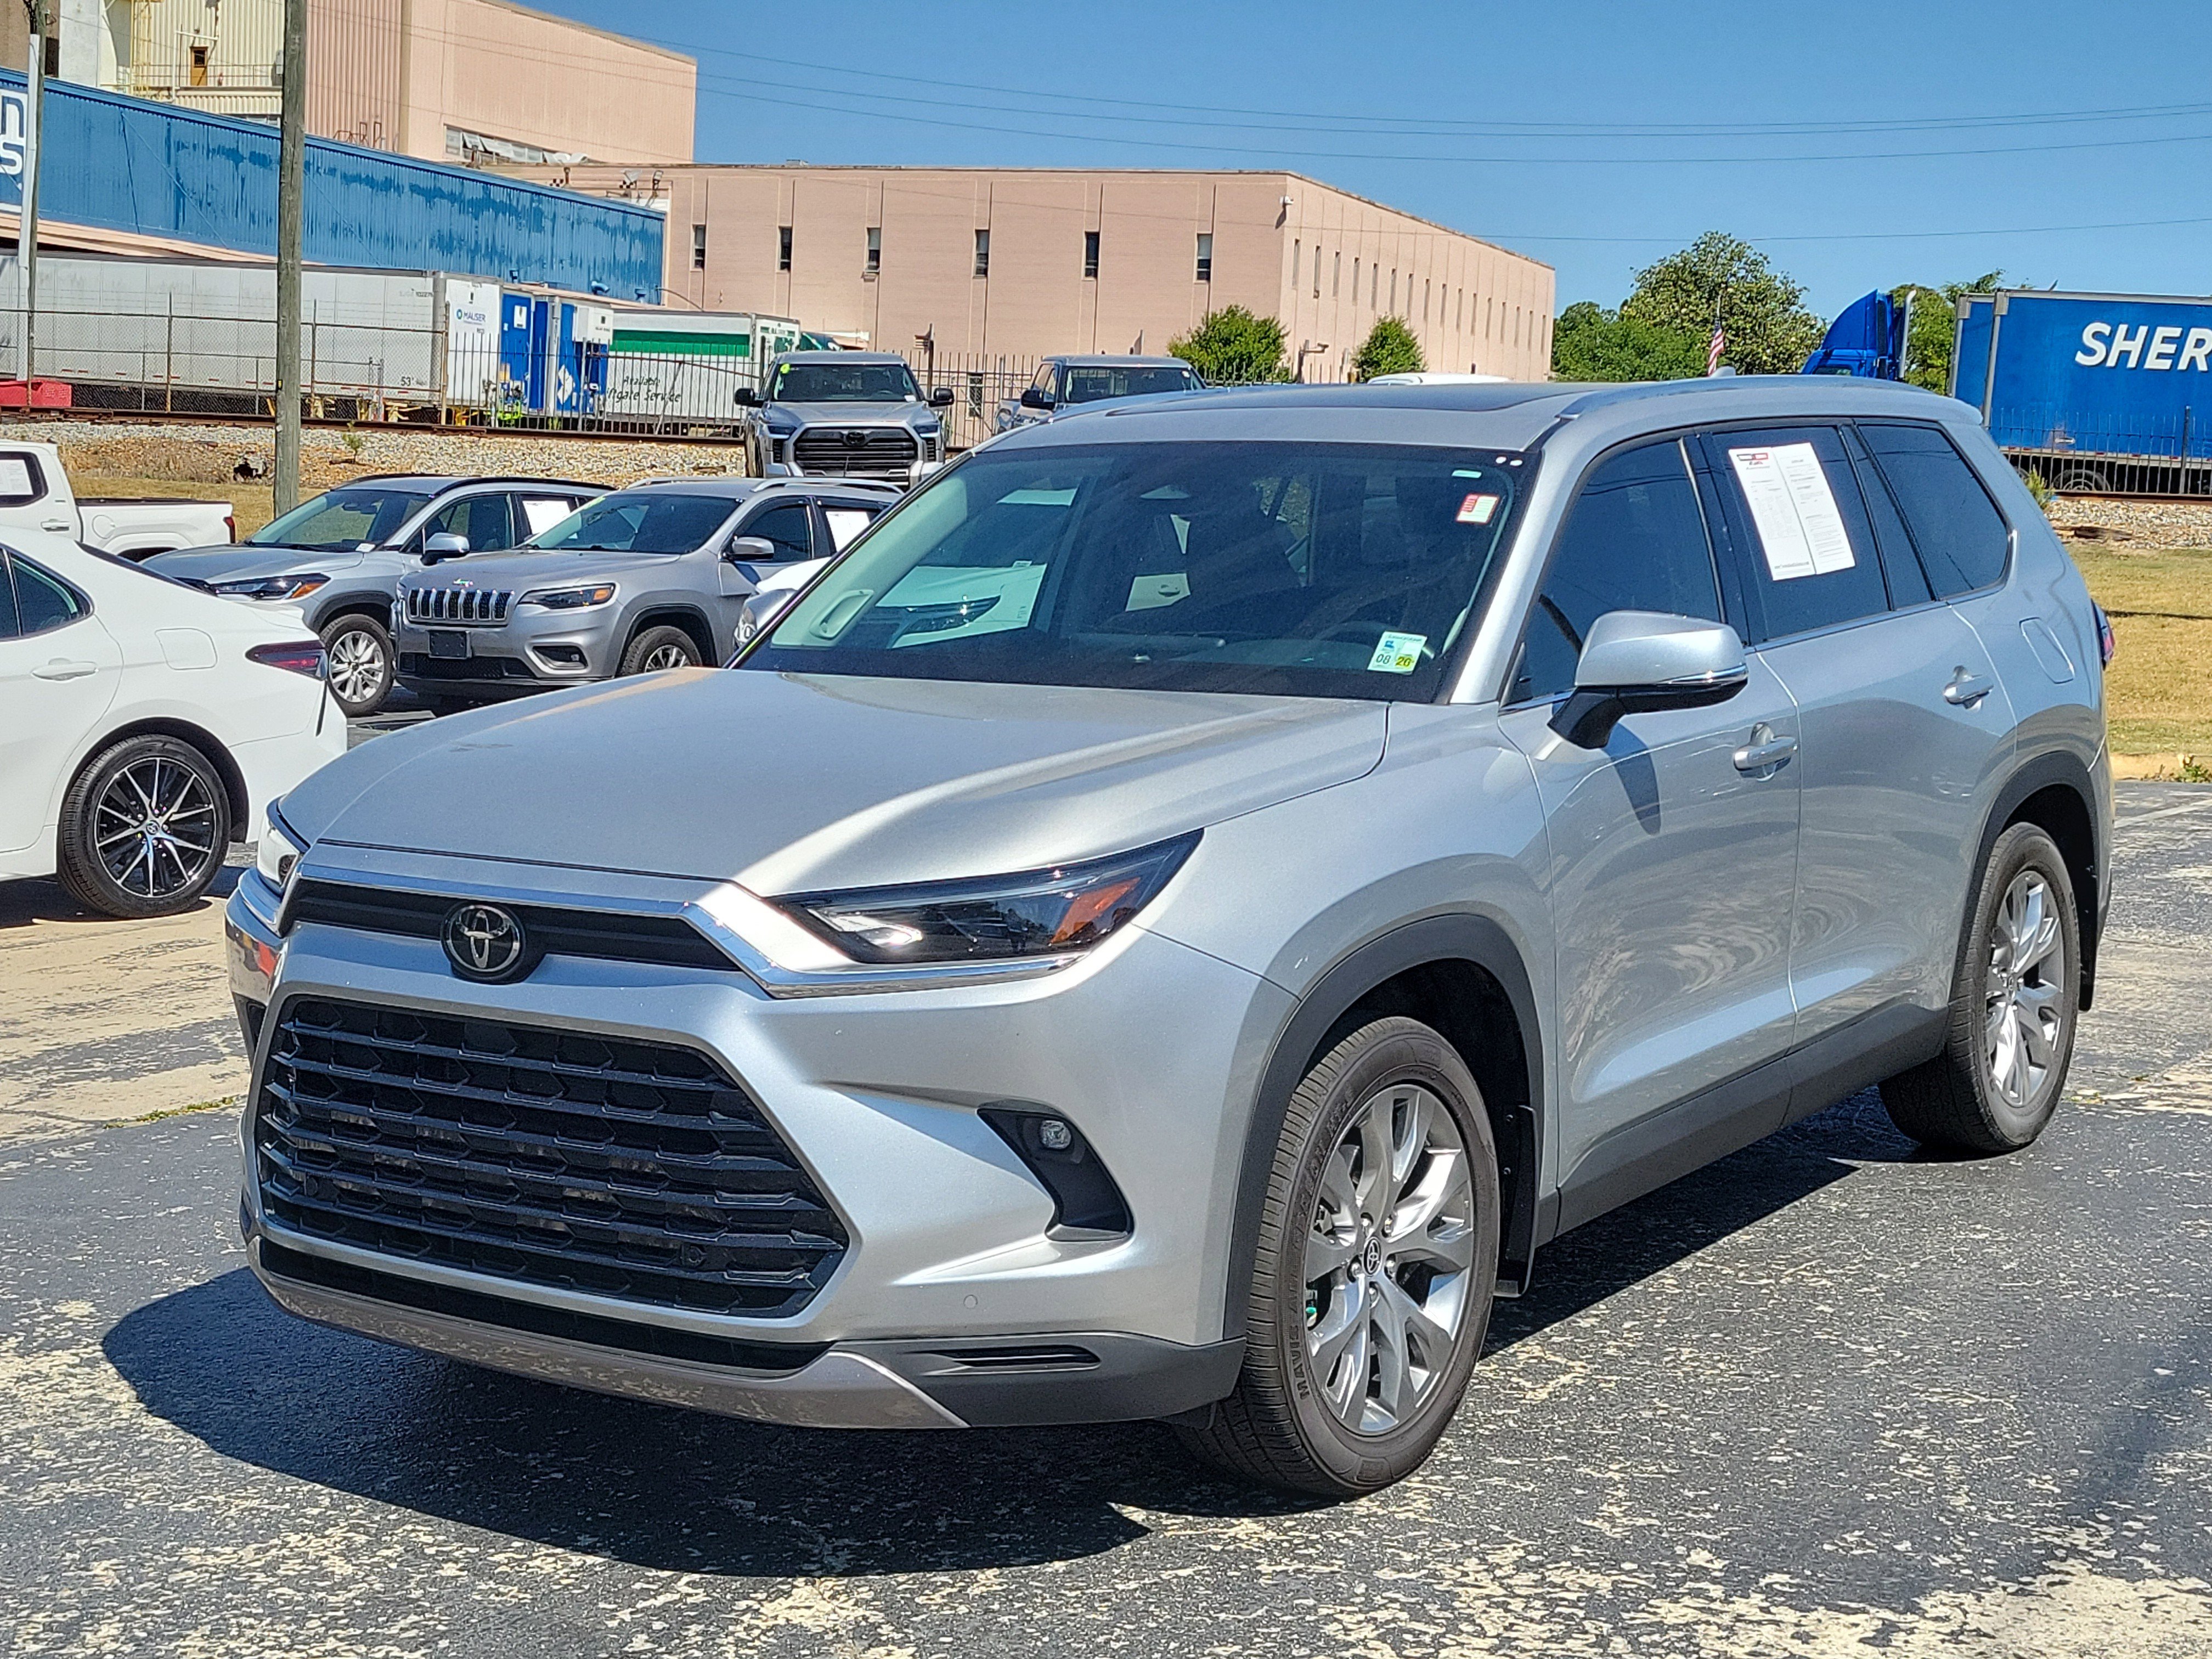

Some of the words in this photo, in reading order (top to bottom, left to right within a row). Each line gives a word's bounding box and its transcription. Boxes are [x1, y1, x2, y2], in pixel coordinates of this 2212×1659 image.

[2075, 321, 2212, 371] SHER
[1376, 654, 1391, 664] 08
[1289, 1324, 1311, 1401] MAVIS
